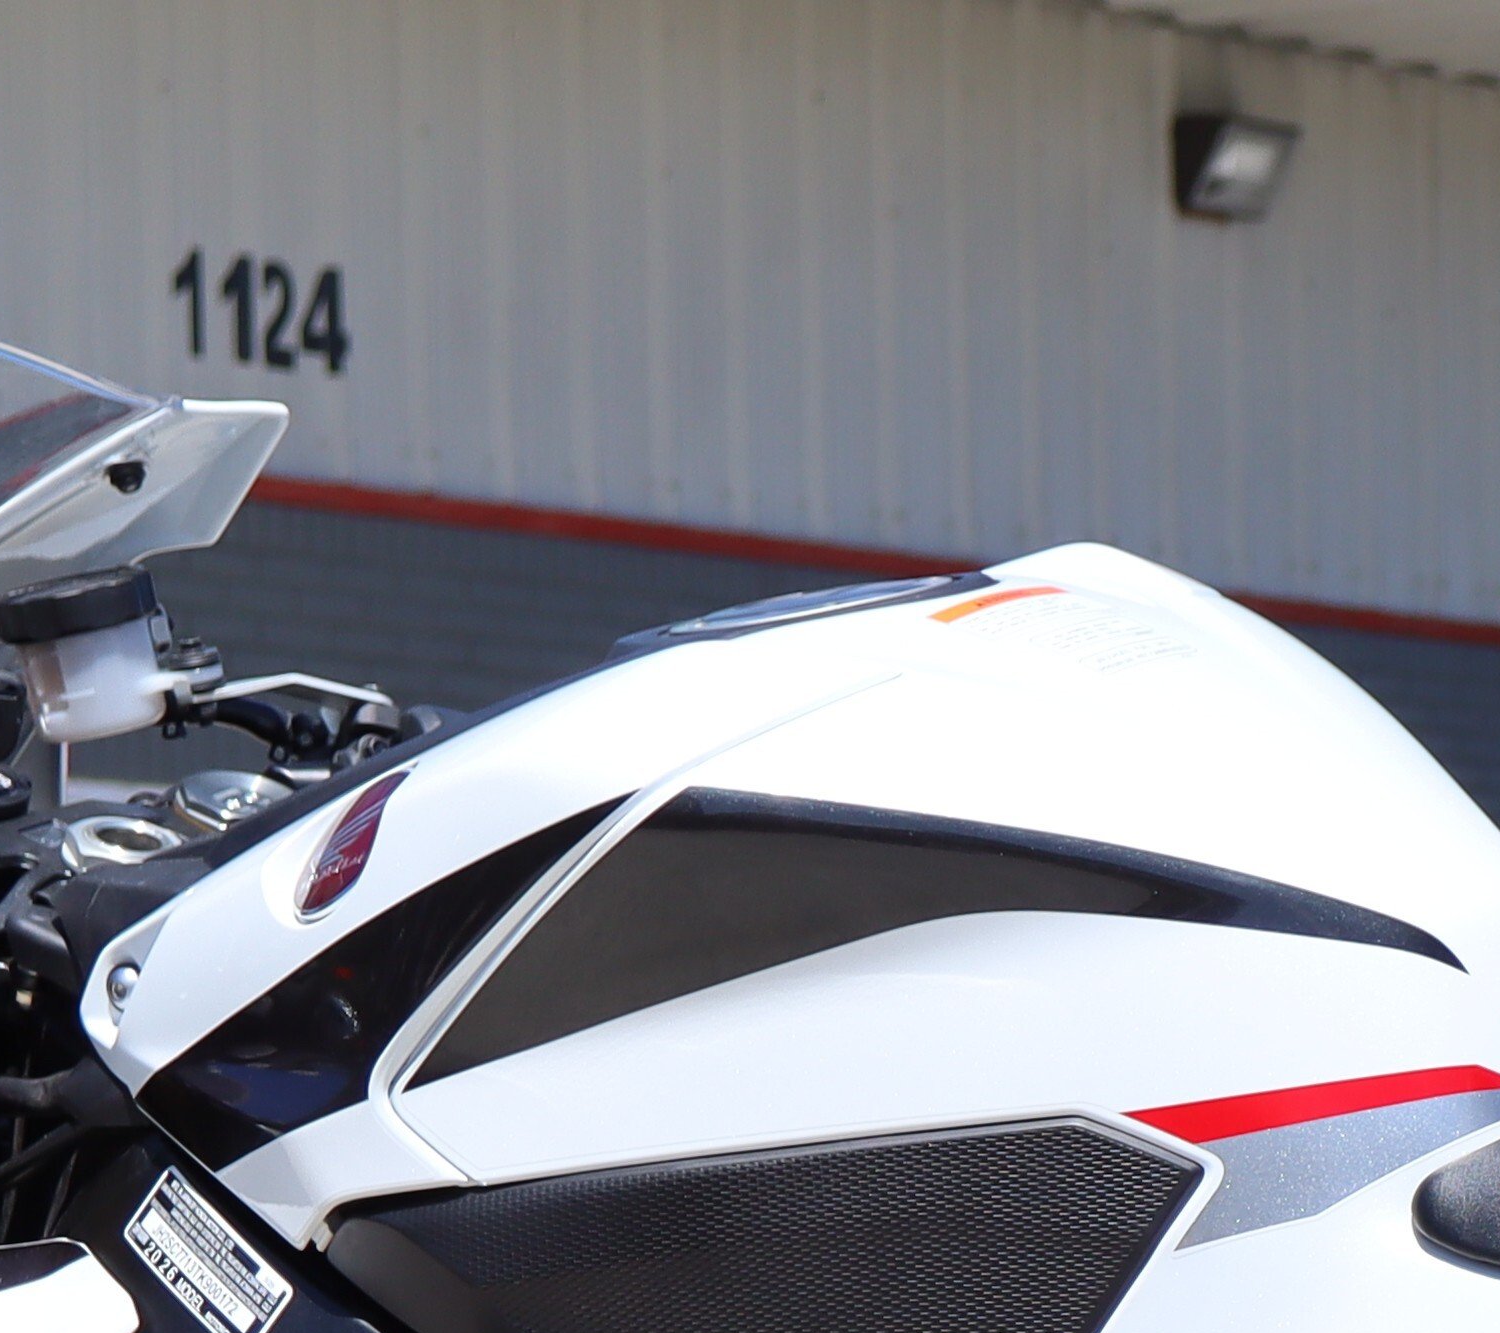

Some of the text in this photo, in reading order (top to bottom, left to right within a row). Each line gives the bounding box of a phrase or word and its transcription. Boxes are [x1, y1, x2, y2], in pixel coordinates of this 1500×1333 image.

[174, 250, 349, 371] 1124
[142, 1240, 179, 1282] 2026
[174, 1274, 207, 1312] MODEL
